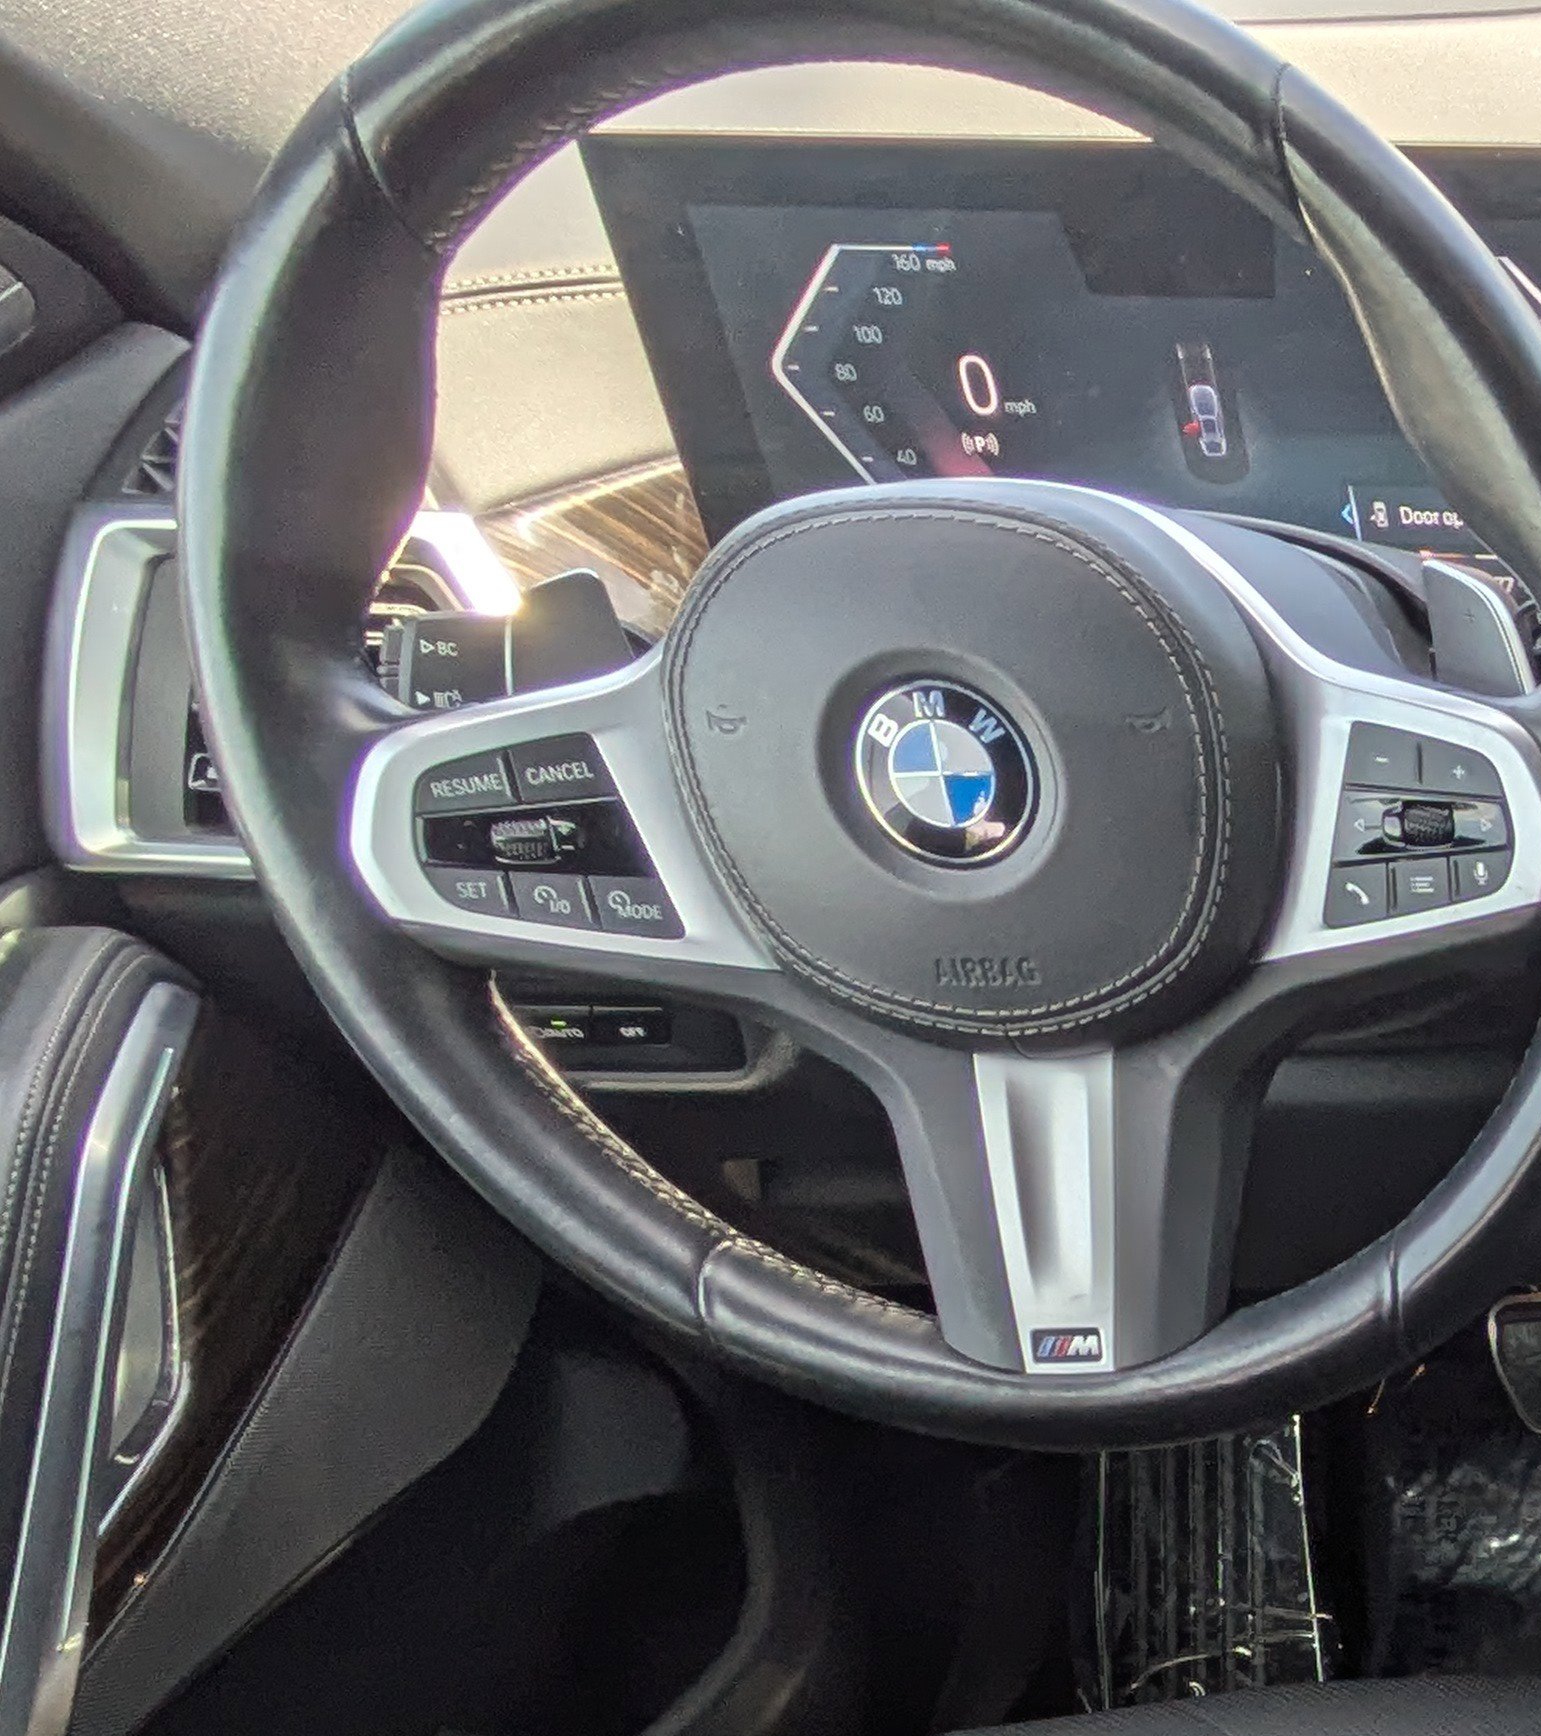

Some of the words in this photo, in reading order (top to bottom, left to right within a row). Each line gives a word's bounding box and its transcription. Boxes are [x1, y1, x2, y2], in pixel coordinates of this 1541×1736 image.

[892, 253, 921, 272] 160
[925, 257, 957, 273] mph
[873, 286, 903, 306] 120
[853, 324, 883, 345] 100
[834, 362, 858, 383] 80
[957, 353, 999, 417] 0
[1004, 399, 1038, 417] mph
[862, 404, 885, 424] 60
[896, 447, 918, 466] 40
[1399, 505, 1440, 526] Door
[524, 760, 596, 786] CANCEL
[429, 772, 502, 799] RESUME
[455, 880, 488, 899] SET
[617, 902, 664, 920] MODE
[934, 955, 1042, 988] AIRBAG
